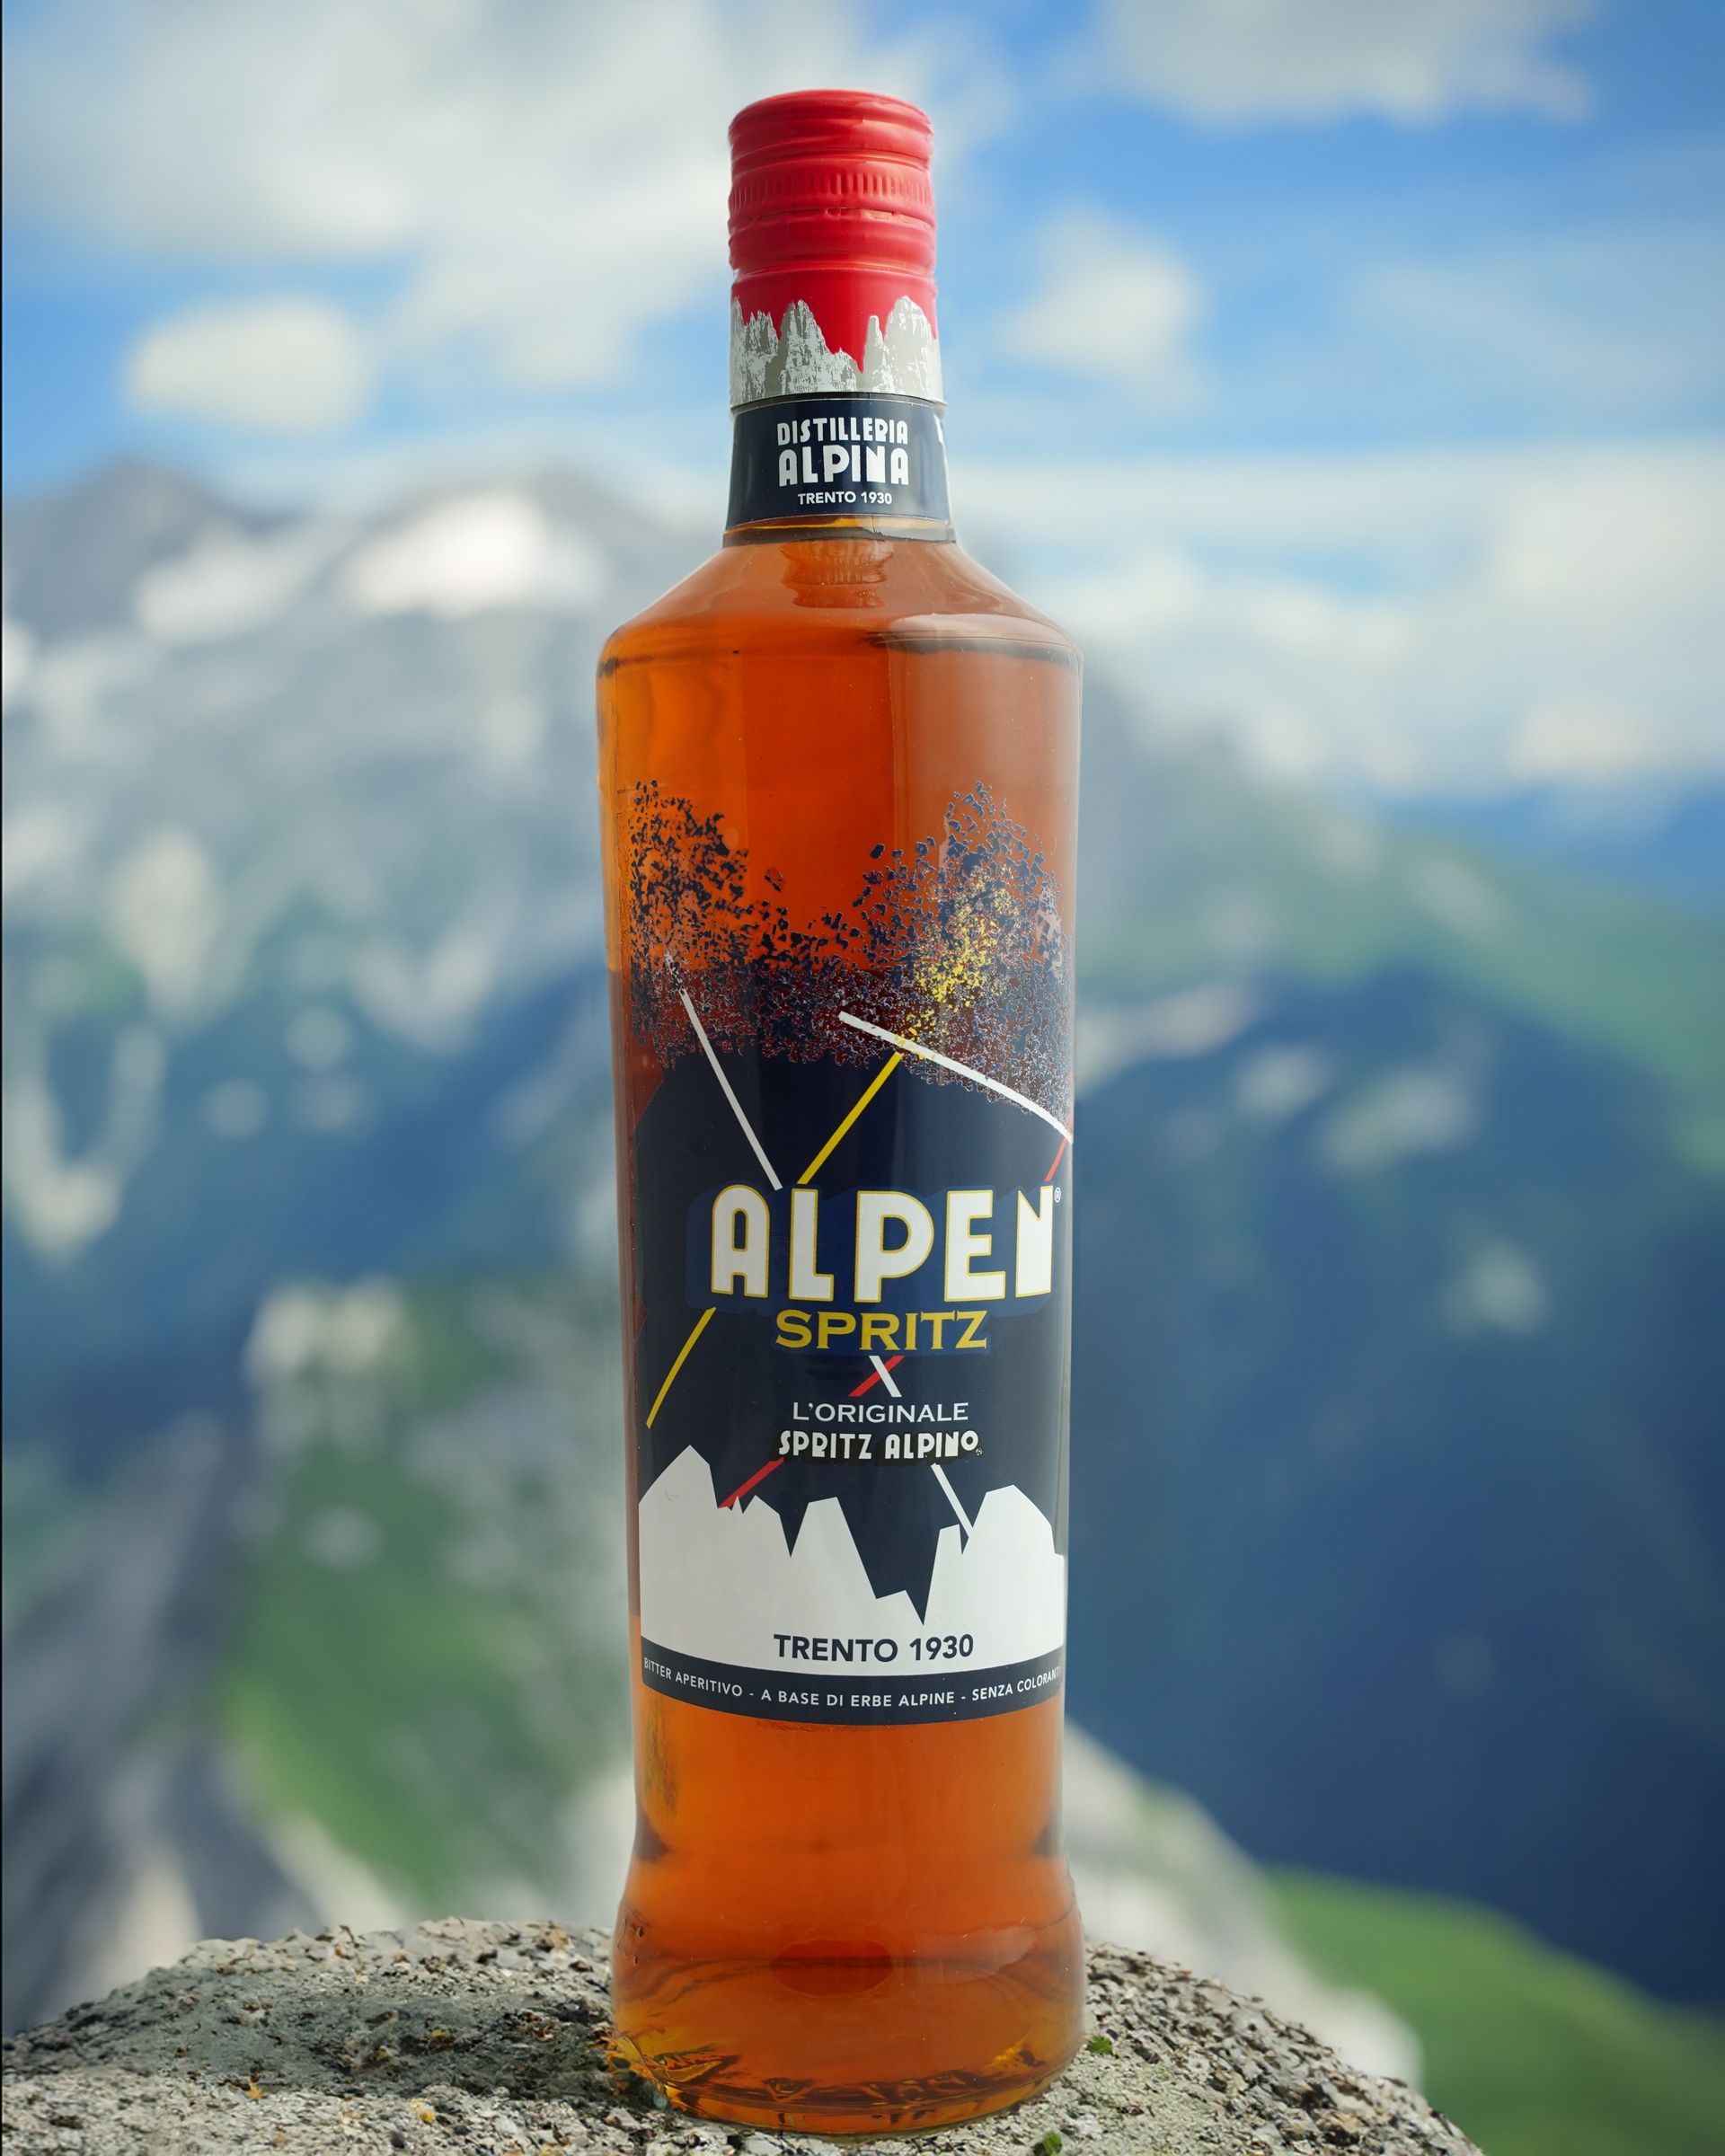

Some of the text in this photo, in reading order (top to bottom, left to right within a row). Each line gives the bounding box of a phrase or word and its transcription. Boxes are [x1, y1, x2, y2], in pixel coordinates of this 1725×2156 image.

[776, 417, 908, 446] DISTILLERIA
[778, 445, 909, 487] ALPINA
[798, 490, 892, 505] TRENTO 1930
[711, 1184, 1054, 1303] ALPEN
[775, 1310, 987, 1351] SPRITZ
[793, 1402, 969, 1423] L'ORIGINALE
[778, 1429, 978, 1460] SPRITZ ALPINO
[774, 1633, 974, 1663] TRENTO 1930
[643, 1657, 672, 1680] BITTER
[675, 1671, 743, 1697] APERITIVO
[760, 1689, 772, 1701] A
[778, 1691, 819, 1706] BASE
[827, 1693, 844, 1706] DI
[851, 1693, 892, 1707] ERBE
[898, 1691, 955, 1707] ALPINE
[971, 1683, 1013, 1701] SENZA
